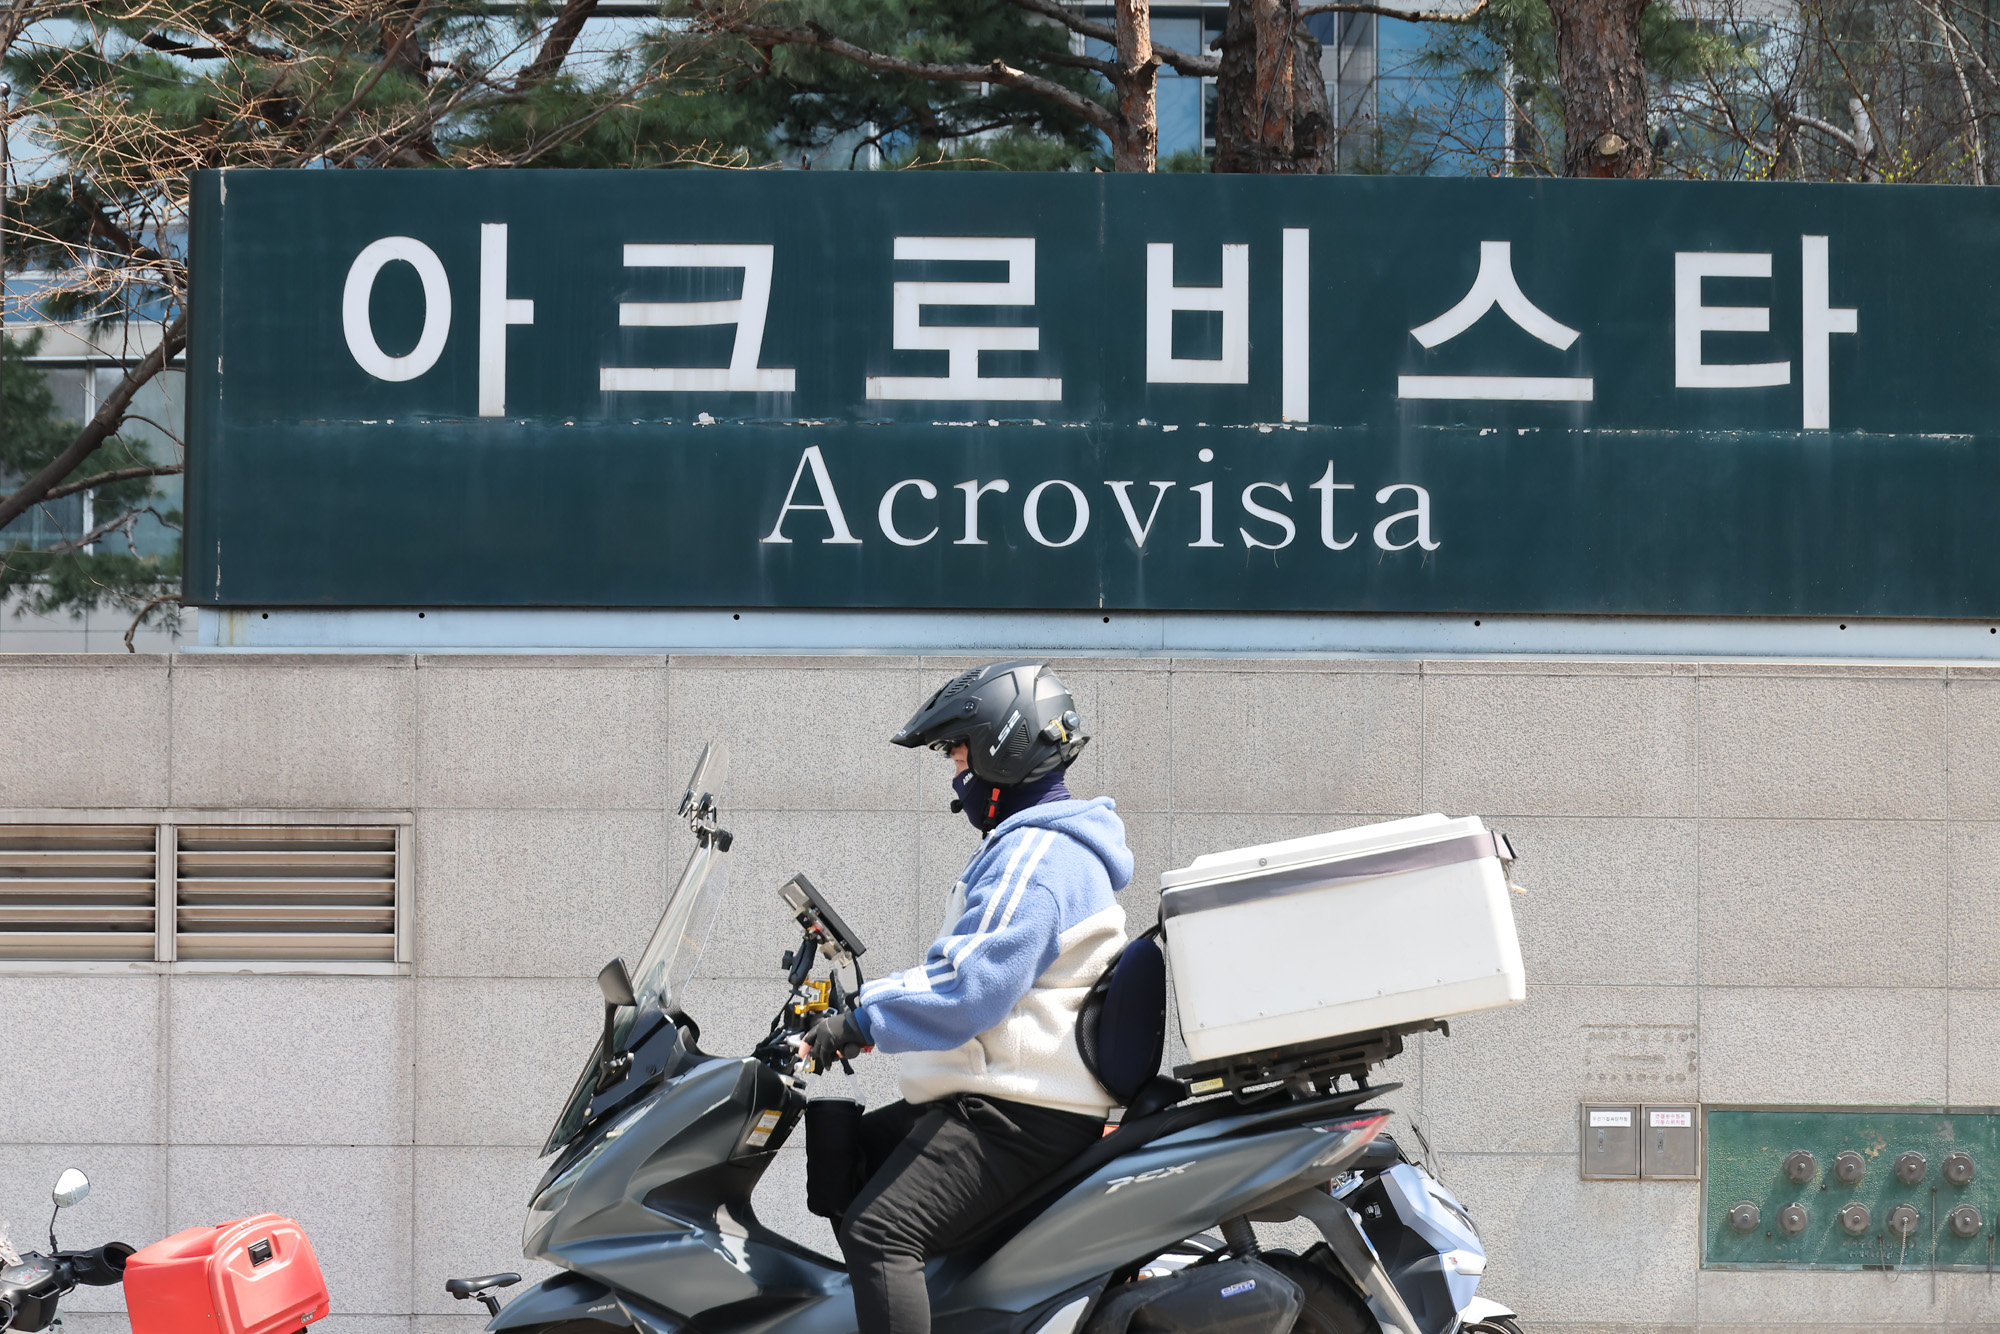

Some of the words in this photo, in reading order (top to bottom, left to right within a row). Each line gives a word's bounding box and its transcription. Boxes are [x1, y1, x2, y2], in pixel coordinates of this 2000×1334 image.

[342, 222, 1860, 430] 아크로비스타
[758, 445, 1441, 551] Acrovista
[989, 709, 1022, 757] LS2
[1104, 1160, 1197, 1195] PCX
